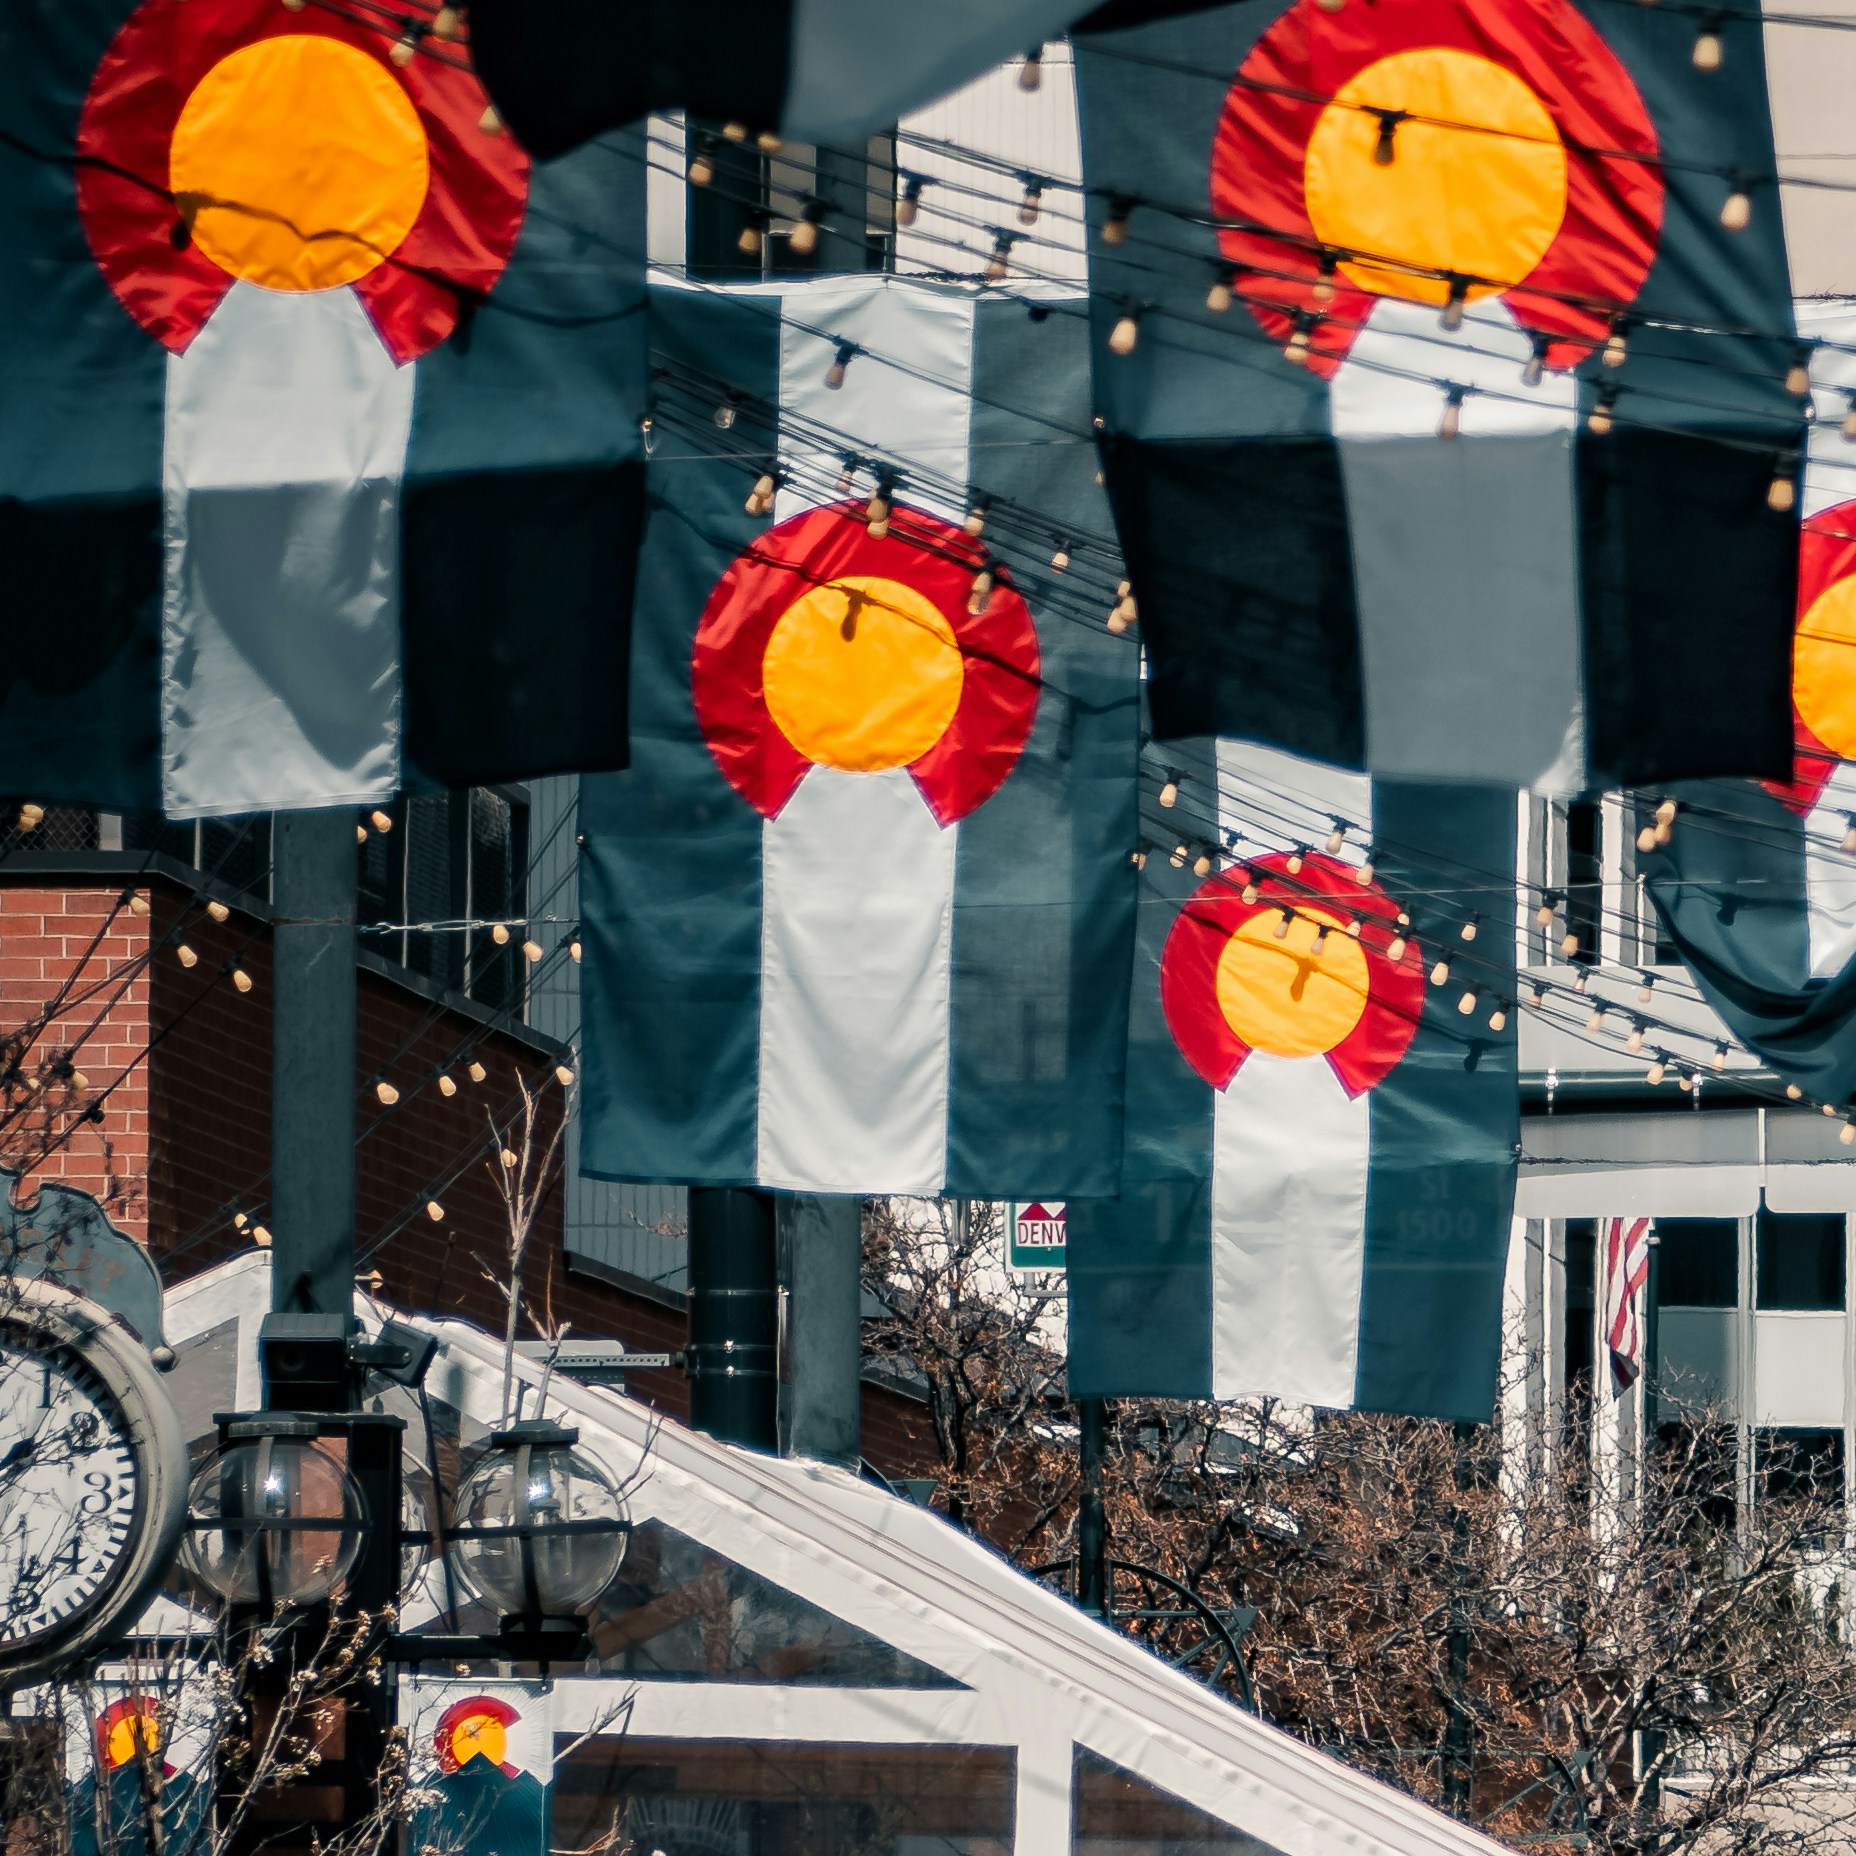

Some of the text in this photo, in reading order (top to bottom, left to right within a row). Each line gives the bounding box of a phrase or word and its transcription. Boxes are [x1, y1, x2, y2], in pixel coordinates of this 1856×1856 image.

[1017, 1222, 1066, 1244] DENV
[1398, 1208, 1478, 1241] 1500
[81, 1471, 112, 1514] 3
